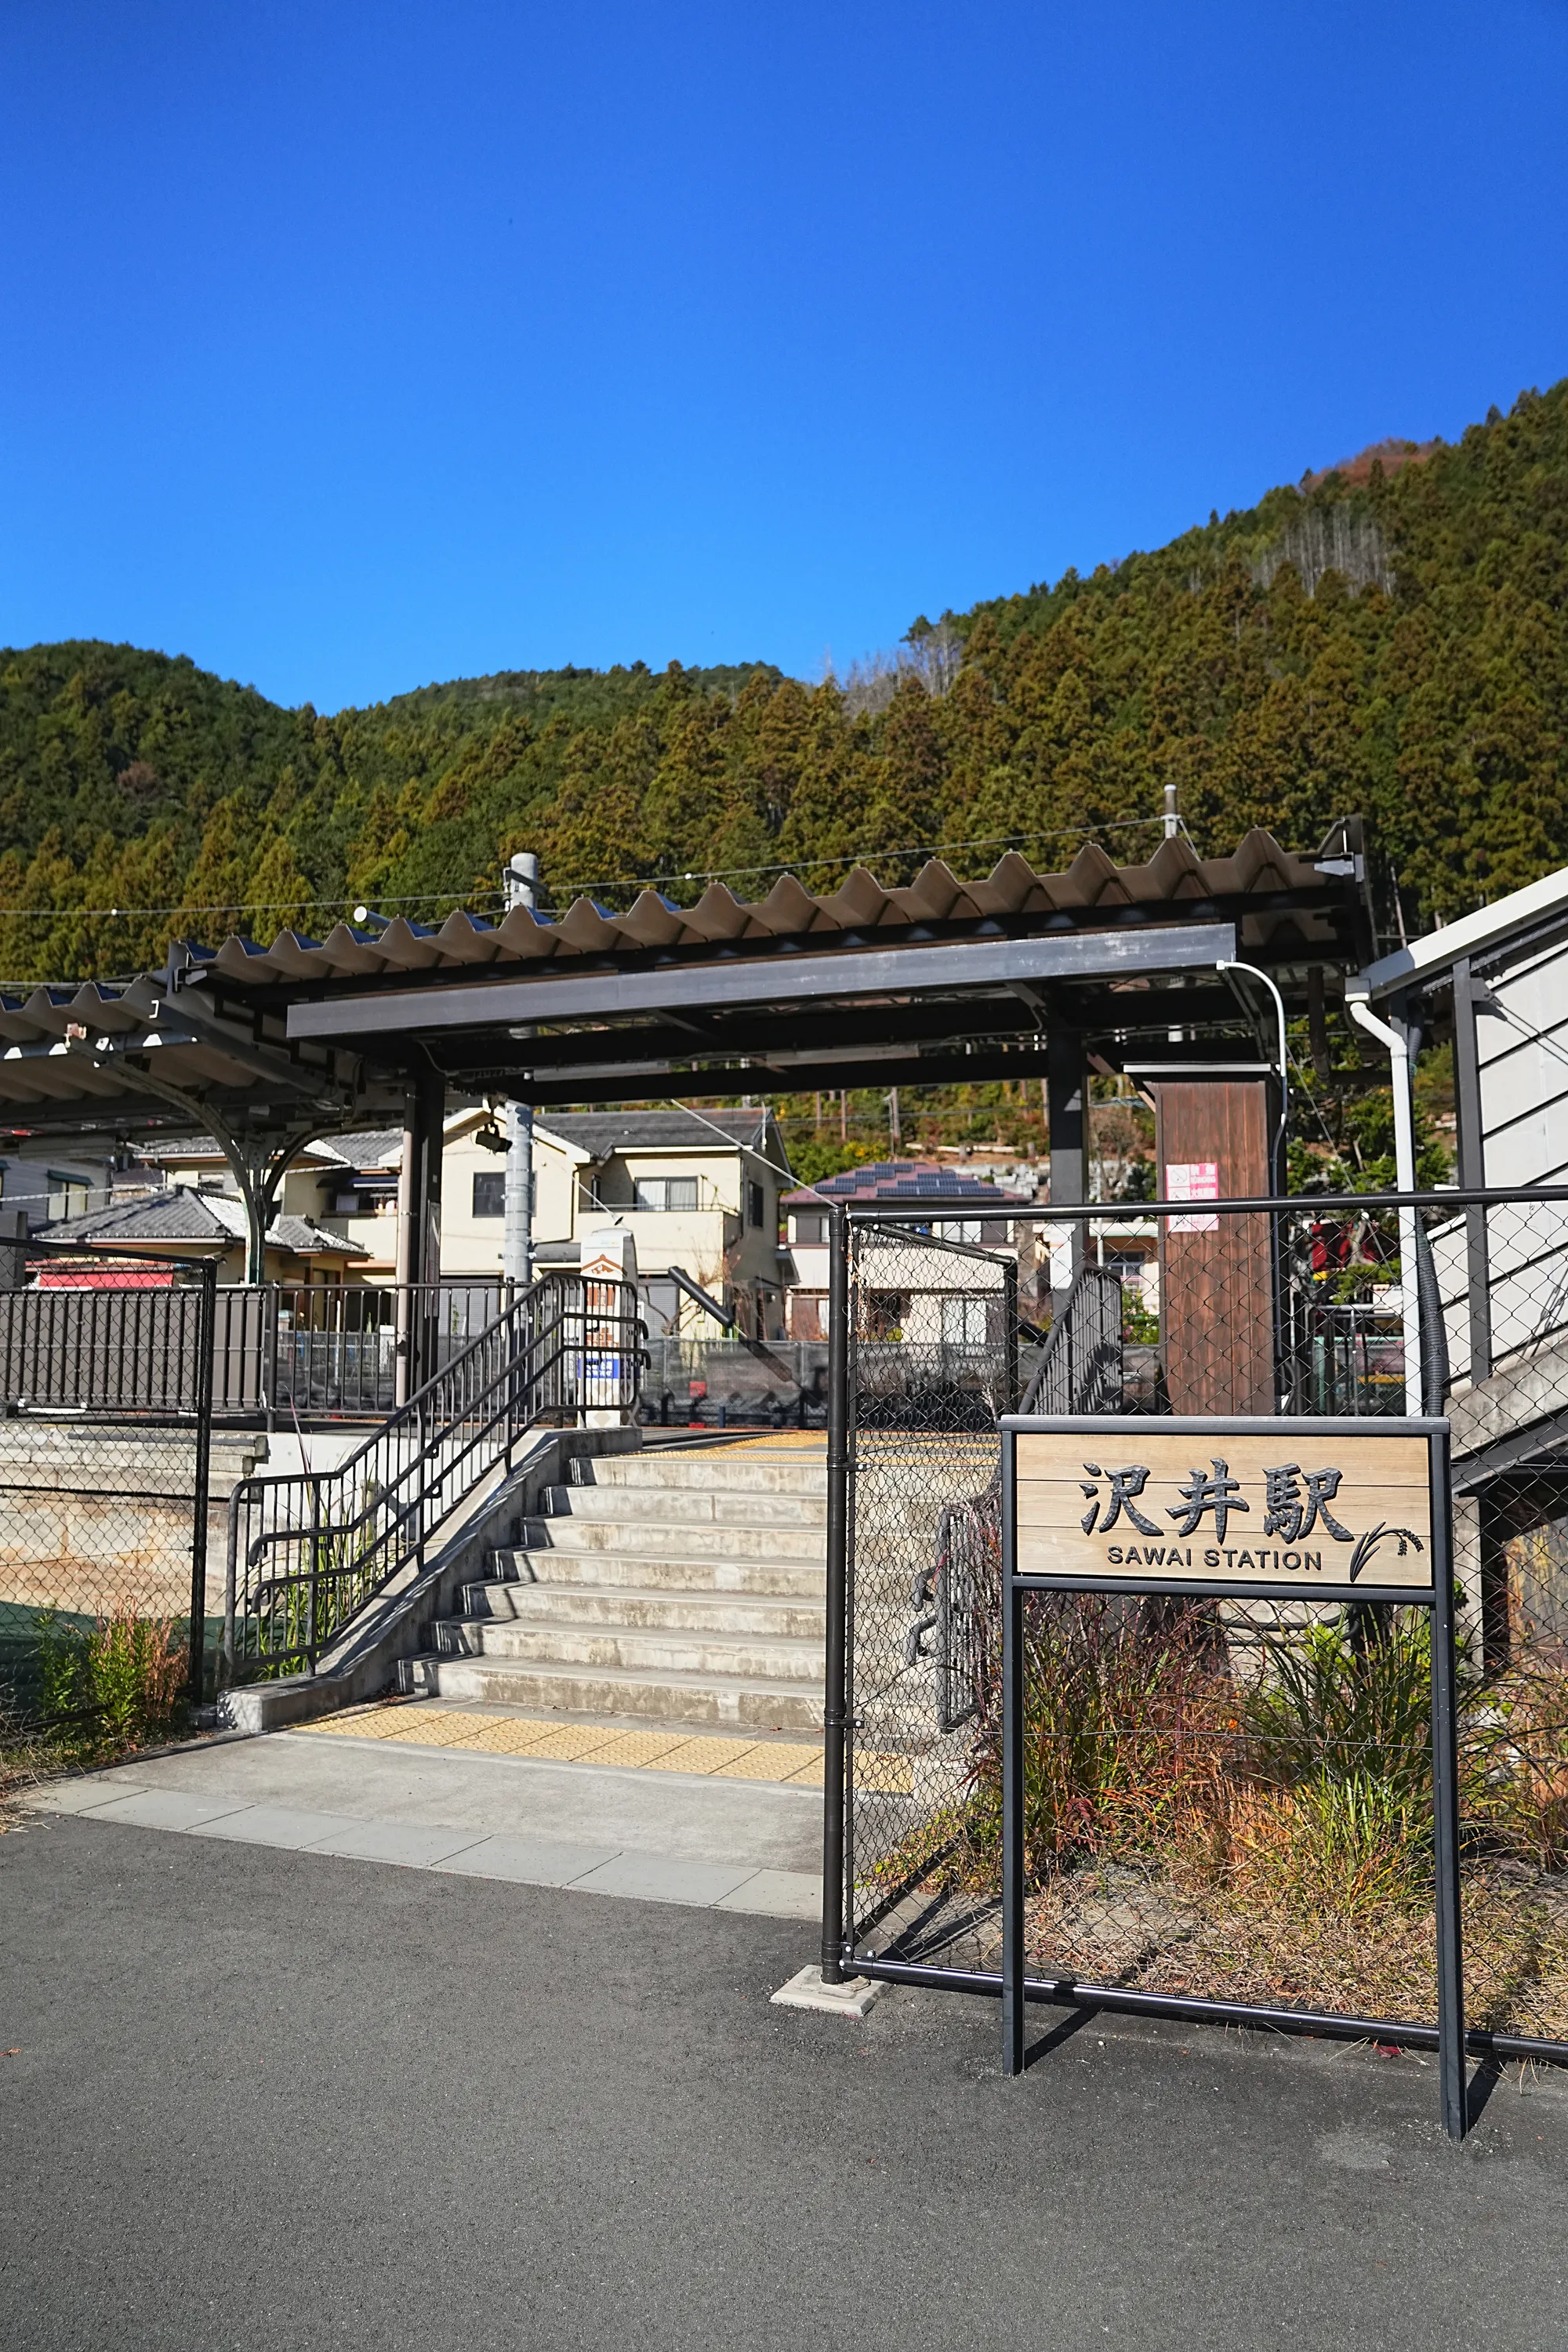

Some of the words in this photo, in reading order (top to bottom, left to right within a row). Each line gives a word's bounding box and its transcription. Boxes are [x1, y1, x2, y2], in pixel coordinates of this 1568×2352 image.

[1079, 1457, 1355, 1544] 沢井駅
[1107, 1545, 1192, 1566] SAWAI
[1203, 1549, 1323, 1570] STATION
